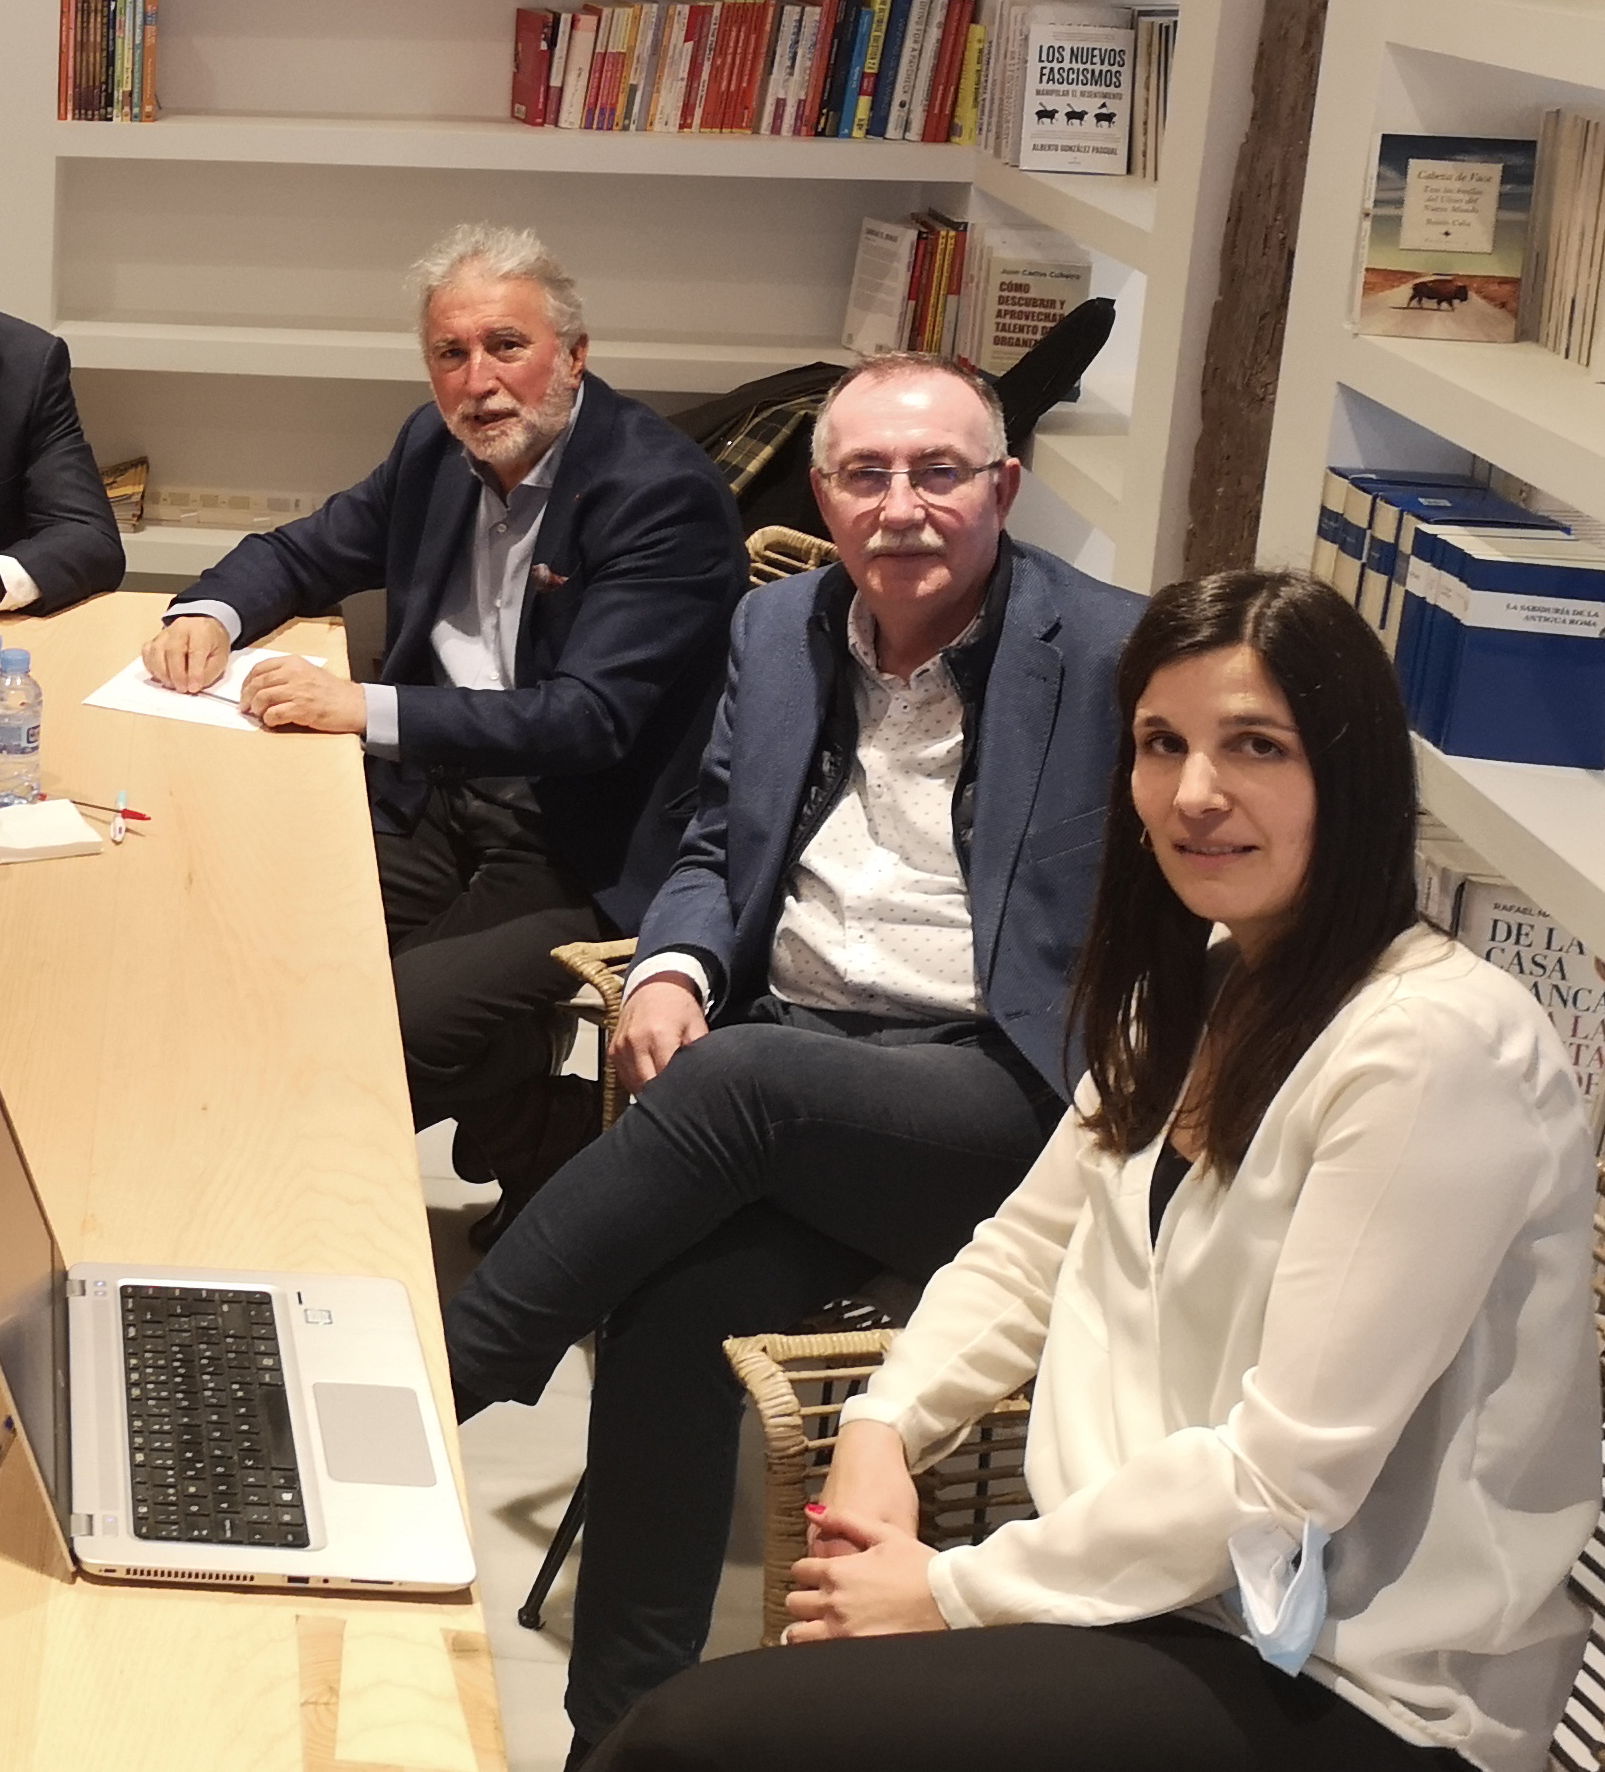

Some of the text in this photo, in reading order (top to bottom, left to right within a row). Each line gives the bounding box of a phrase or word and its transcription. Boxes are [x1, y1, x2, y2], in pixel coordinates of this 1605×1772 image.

[1038, 45, 1126, 68] LOS NUEVOS
[1039, 66, 1122, 88] FASCISMOS
[999, 280, 1030, 294] CÓMO
[997, 295, 1067, 309] DESCUBRIR Y
[995, 322, 1039, 336] TALENTO
[1506, 603, 1518, 611] LA
[1588, 610, 1599, 618] LA
[1524, 615, 1567, 625] ANTIGUA
[1493, 902, 1534, 917] RAFAEL
[1488, 918, 1587, 956] DE LA
[1484, 946, 1569, 983] CASA
[1530, 980, 1605, 1013] ANCA
